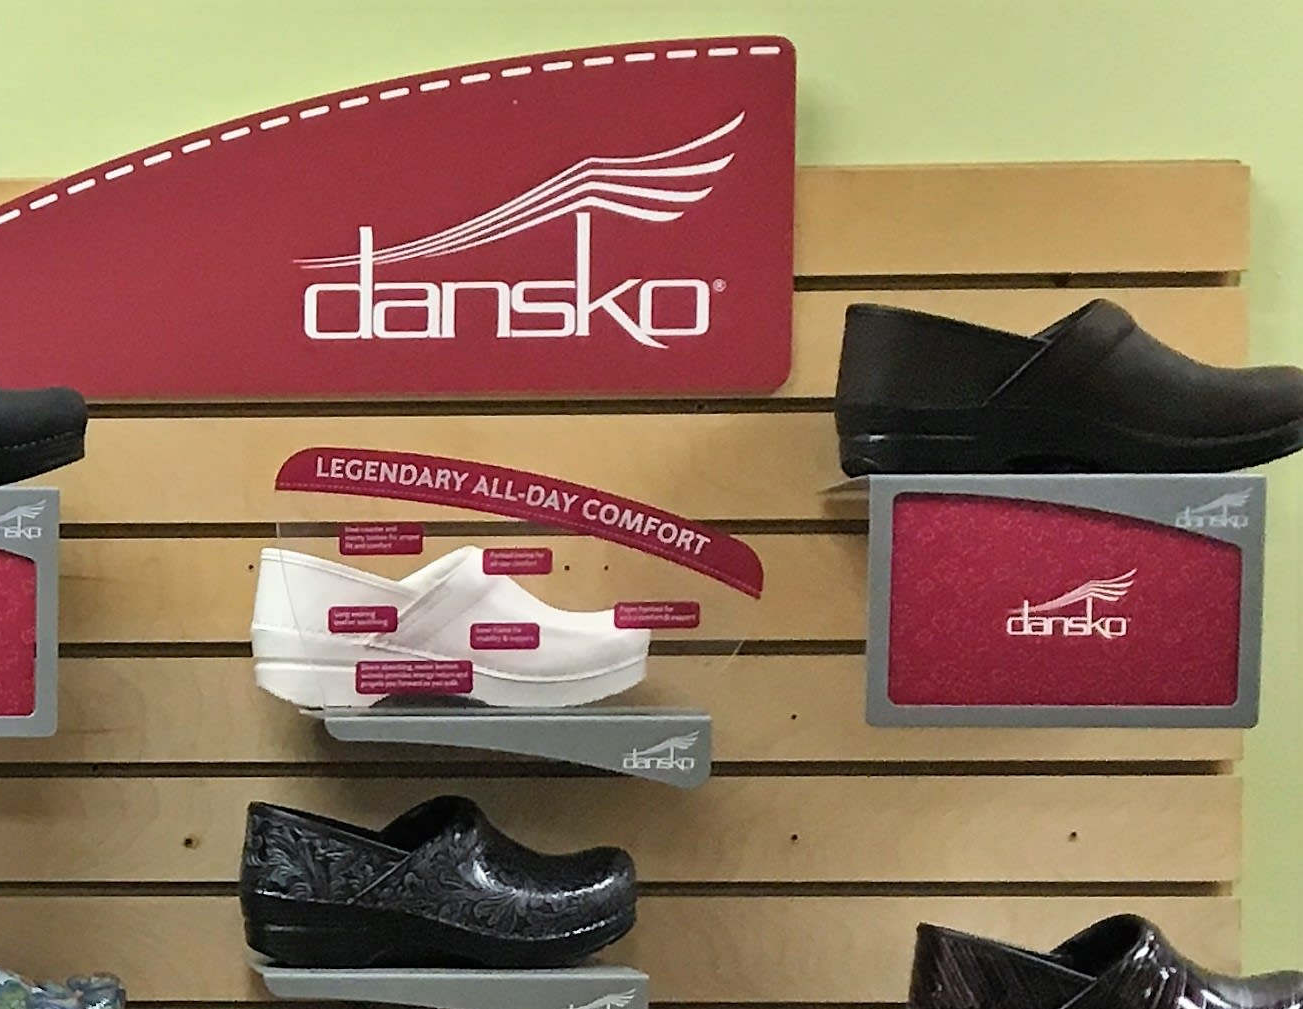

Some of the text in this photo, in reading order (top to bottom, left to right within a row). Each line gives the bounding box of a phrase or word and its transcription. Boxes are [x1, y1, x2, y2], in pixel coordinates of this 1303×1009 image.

[304, 212, 710, 348] dansko
[316, 455, 712, 556] LEGENDARY ALL-DAY COMFORT
[1006, 597, 1127, 639] dansko
